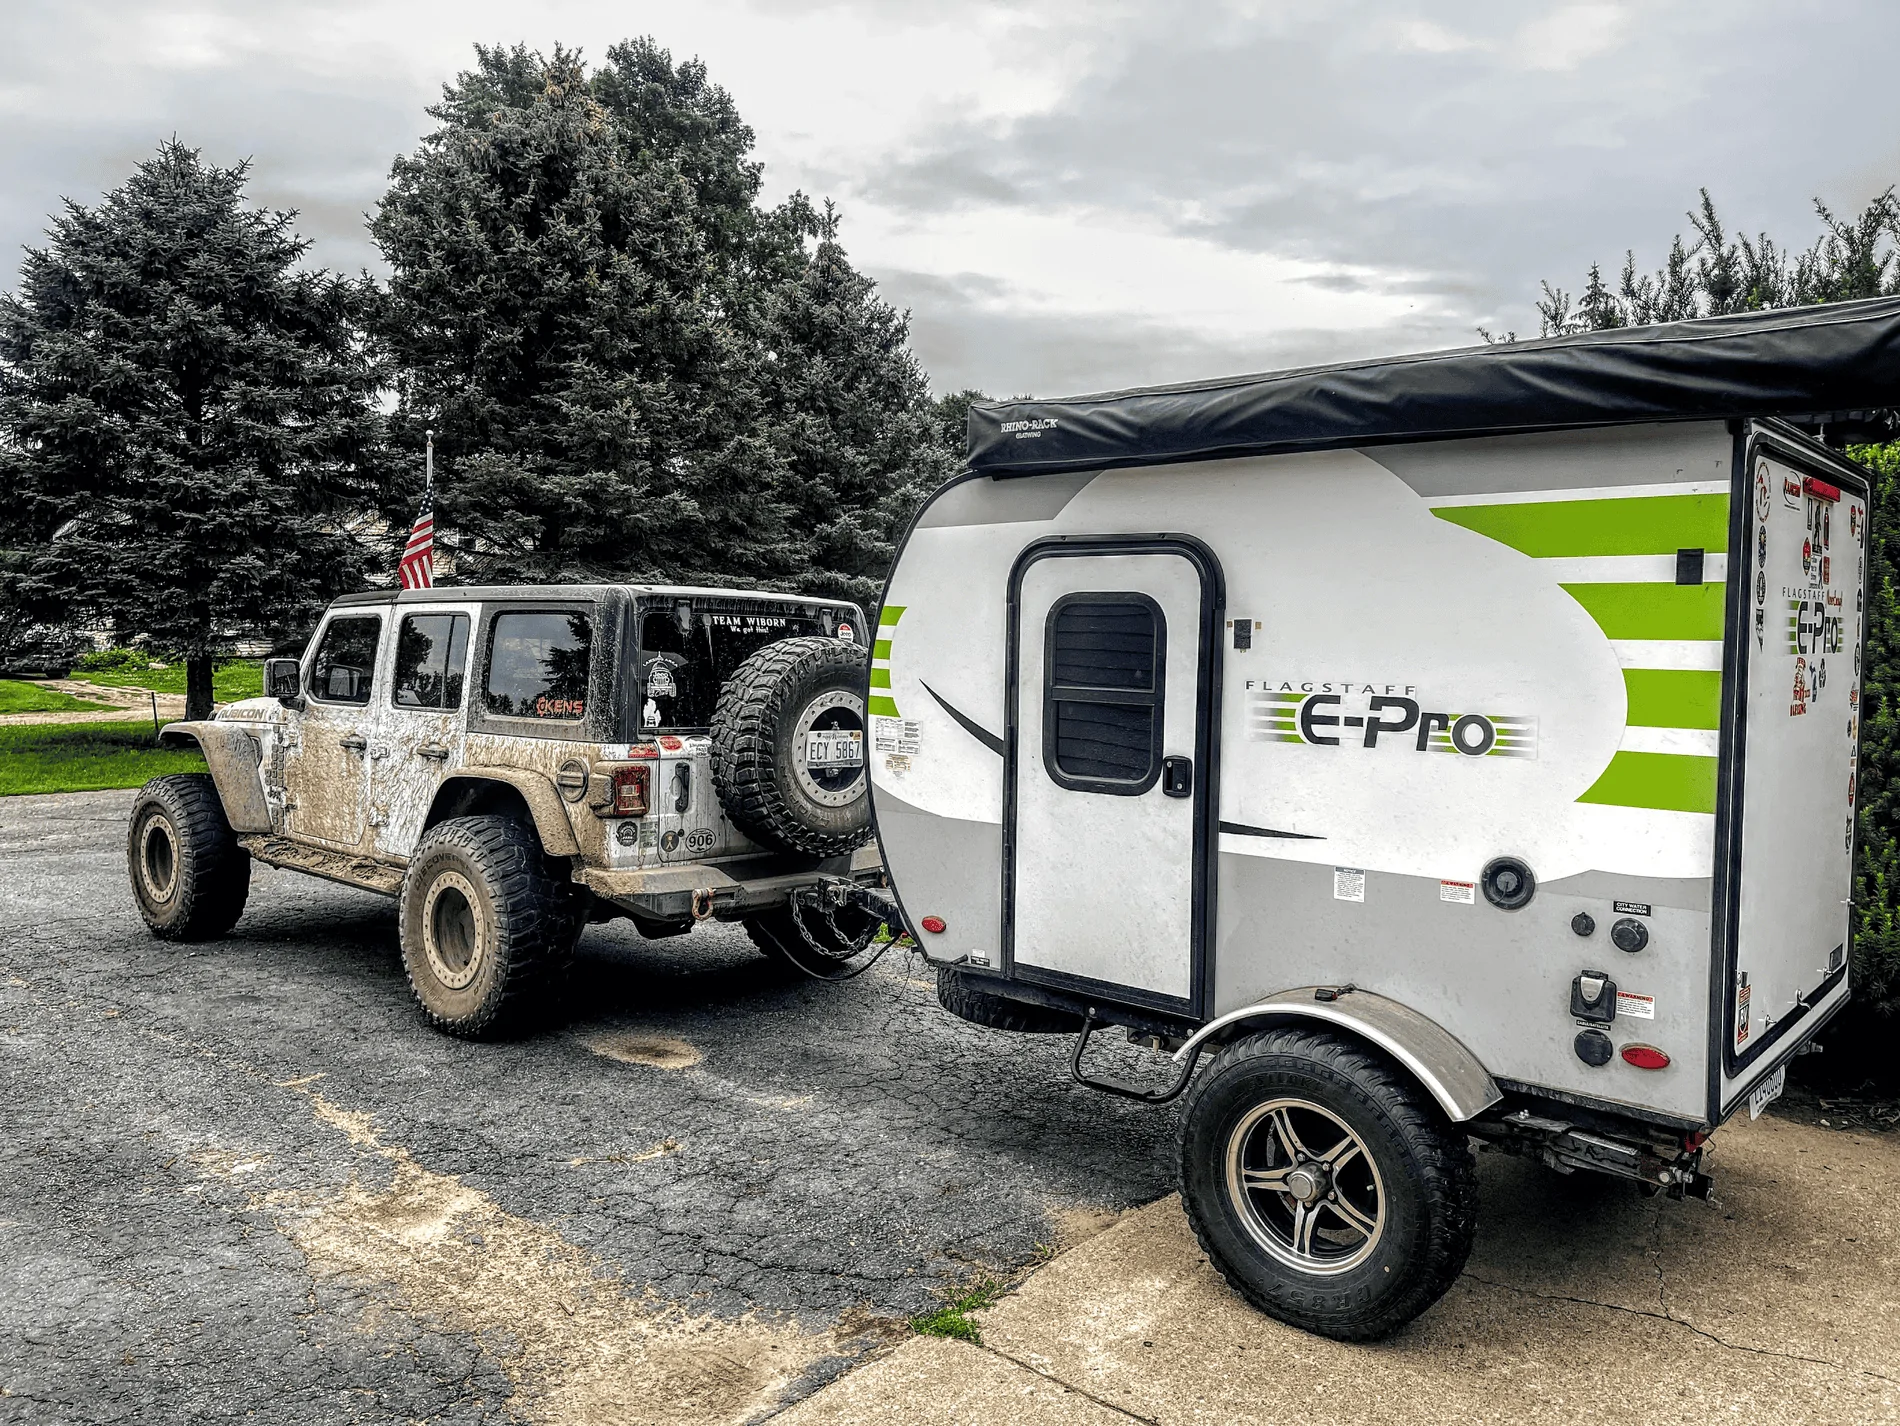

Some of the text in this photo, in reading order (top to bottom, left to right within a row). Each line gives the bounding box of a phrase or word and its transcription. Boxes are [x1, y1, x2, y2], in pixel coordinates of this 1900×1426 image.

[1001, 419, 1059, 433] RHINO-RACK
[1782, 587, 1825, 600] FLAGSTAFF
[712, 616, 786, 628] TEAM WIBORN
[1245, 681, 1416, 695] FLAGSTAFF
[218, 708, 266, 719] RUBICON
[810, 742, 830, 760] ECY
[836, 741, 860, 759] 5867
[688, 834, 714, 848] 906
[1615, 906, 1648, 914] CONNECTION
